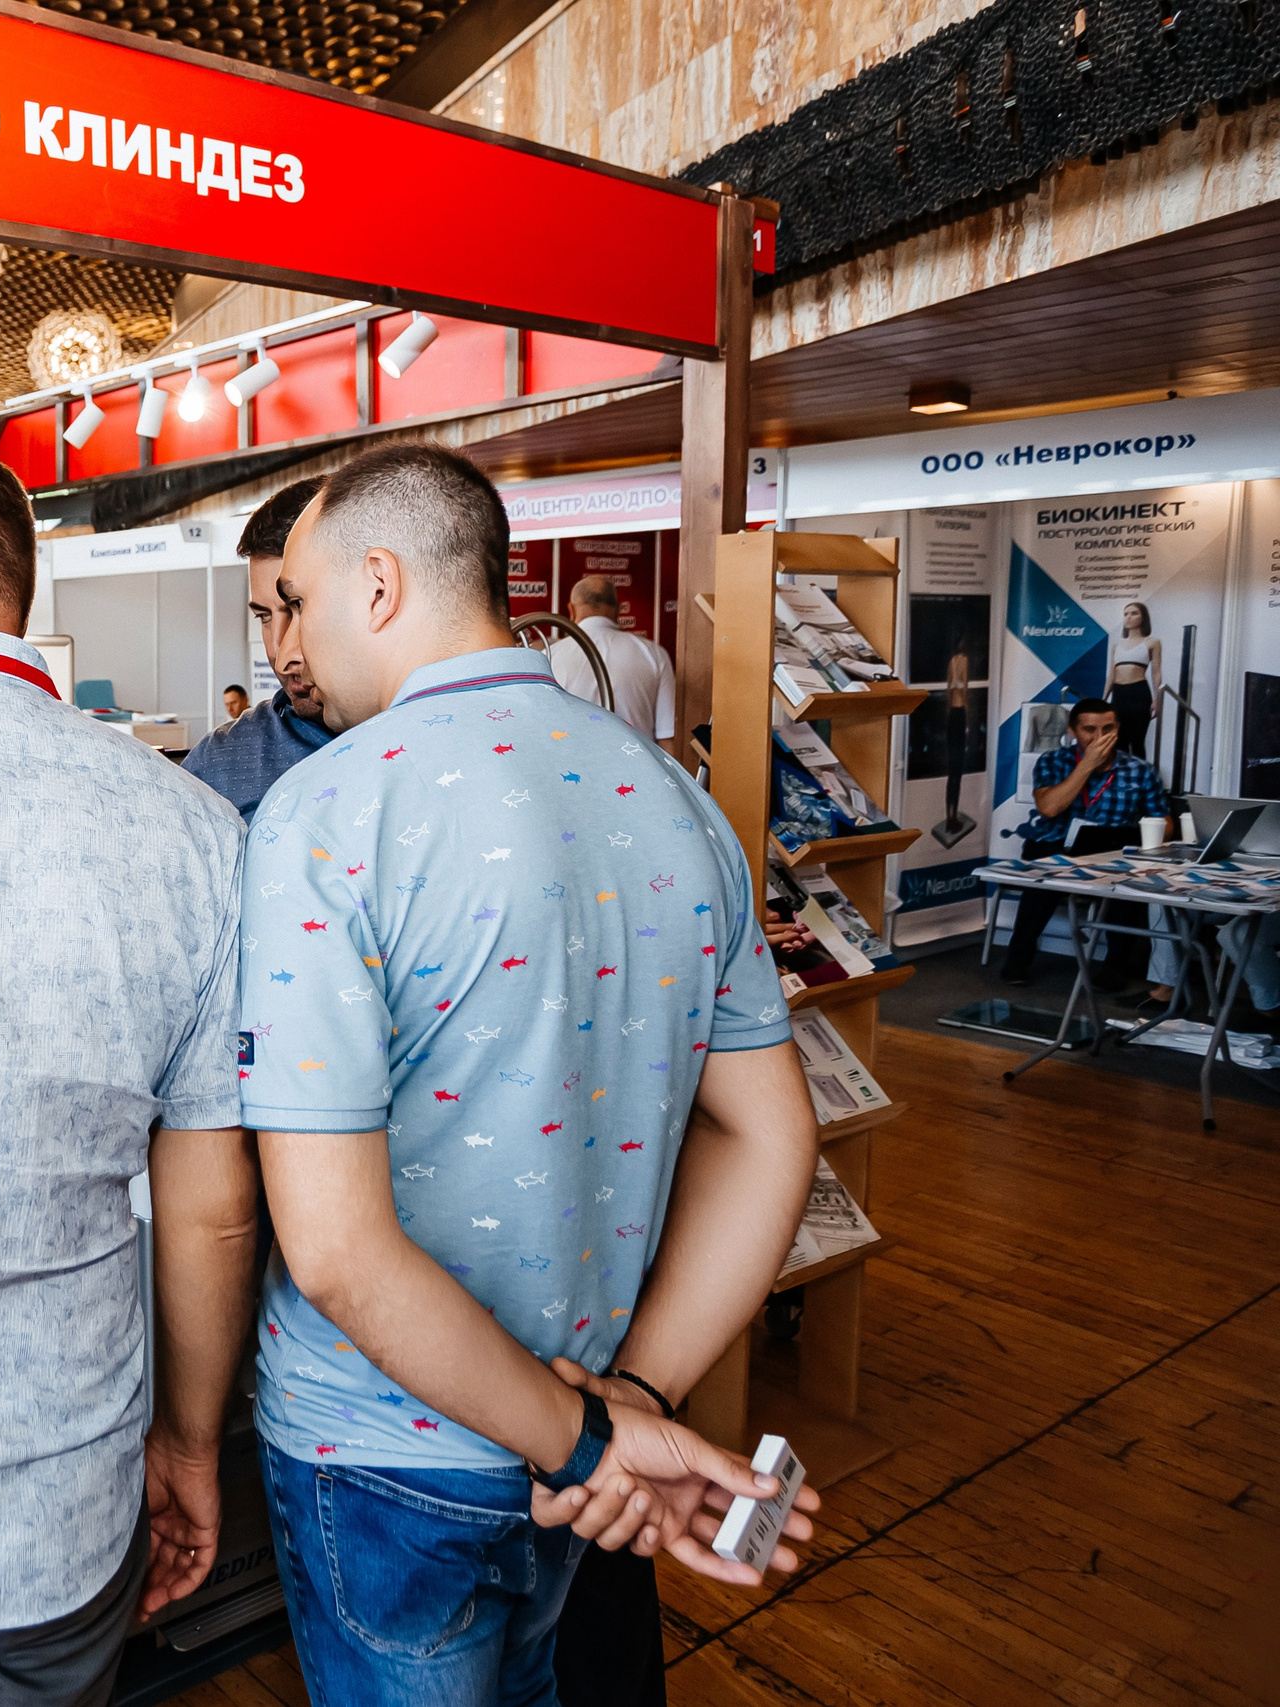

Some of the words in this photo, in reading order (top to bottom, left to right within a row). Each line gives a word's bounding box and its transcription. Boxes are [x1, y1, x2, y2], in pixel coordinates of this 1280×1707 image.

[24, 100, 305, 203] КЛИНДЕЗ
[921, 451, 984, 474] ООО
[995, 433, 1196, 467] «Неврокор»
[753, 457, 767, 475] 3
[531, 497, 582, 516] ЦЕНТР
[587, 493, 623, 511] АНО
[628, 488, 667, 510] ДПО
[1037, 501, 1185, 525] БИОКИНЕКТ
[189, 528, 201, 537] 12
[1038, 519, 1195, 539] ПОСТУРОЛОГИЧЕСКИЙ
[1074, 537, 1151, 550] КОМПЛЕКС
[1023, 625, 1085, 637] Neurocor
